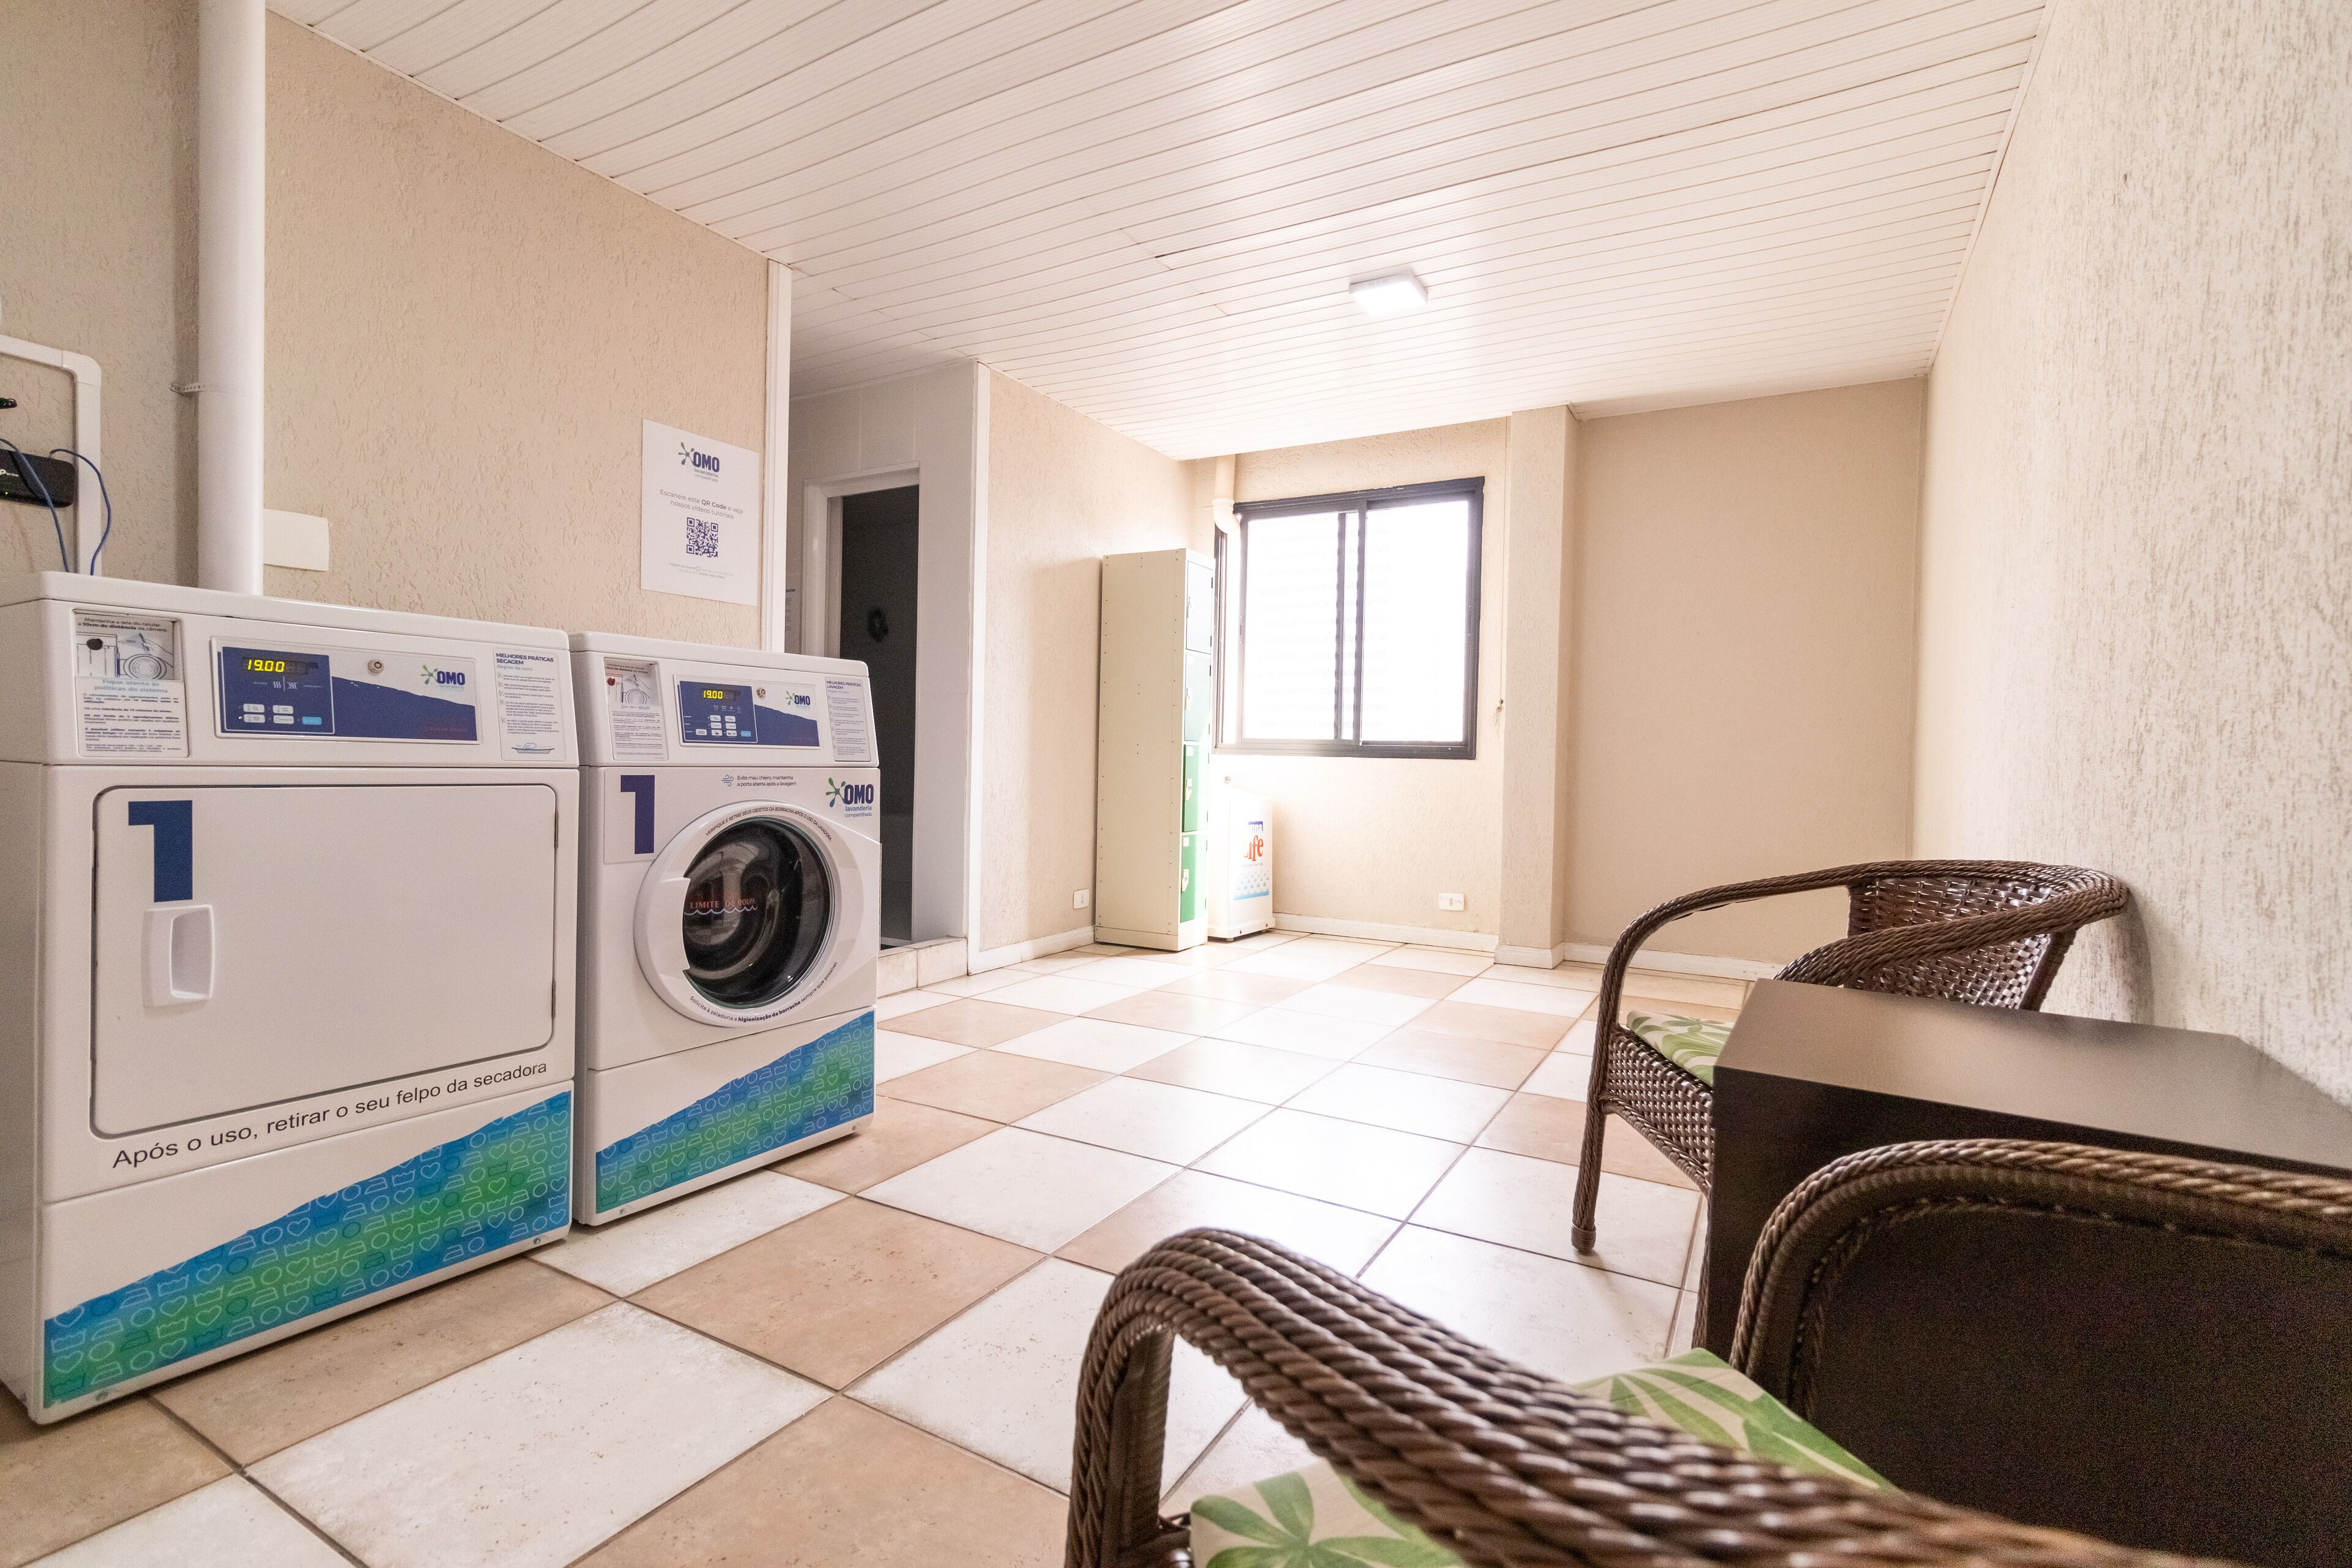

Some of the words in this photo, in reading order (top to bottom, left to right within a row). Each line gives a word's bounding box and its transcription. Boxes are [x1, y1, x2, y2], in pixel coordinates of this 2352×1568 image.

[693, 451, 720, 472] OMO
[694, 468, 718, 478] lavanderia
[660, 489, 687, 500] Escaneie
[670, 500, 691, 509] nossos
[692, 505, 710, 514] vídeos
[711, 510, 734, 519] tutoriais
[247, 658, 285, 673] 19.00
[437, 671, 466, 685] OMO
[703, 690, 723, 699] 19.00
[794, 695, 810, 706] OMO
[844, 784, 874, 804] OMO
[620, 775, 655, 854] 1
[706, 820, 726, 836] VERIFIQUE
[729, 812, 742, 822] RETIRE
[128, 800, 193, 903] 1
[690, 900, 720, 909] LIMITE
[690, 995, 707, 1011] Solicite
[710, 1009, 733, 1022] zeladoria
[737, 1014, 772, 1023] higienização
[778, 1000, 801, 1015] borracha
[801, 988, 817, 1003] sempre
[113, 1142, 178, 1169] Após
[187, 1139, 202, 1151] o
[211, 1127, 257, 1147] uso,
[267, 1109, 330, 1134] retirar
[336, 1106, 349, 1118] o
[355, 1096, 390, 1114] seu
[396, 1086, 441, 1105] felpo
[447, 1079, 468, 1093] da
[473, 1063, 547, 1088] secadora
